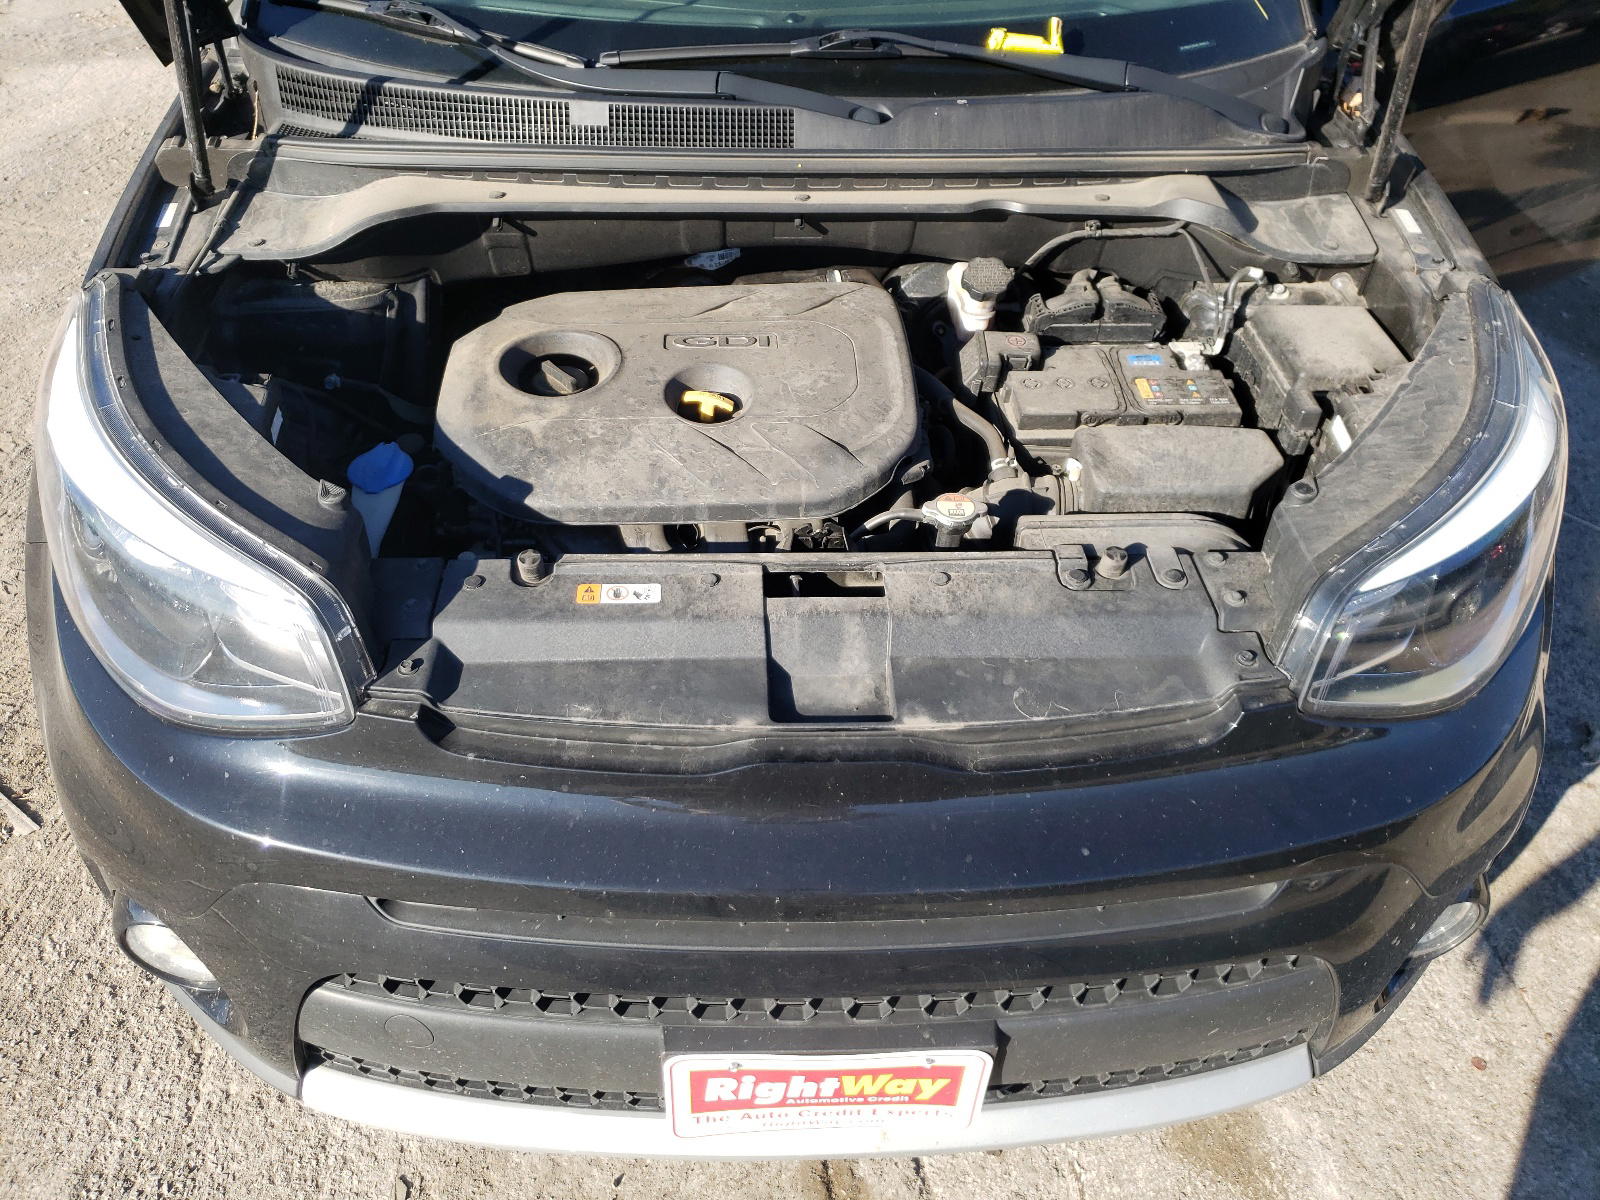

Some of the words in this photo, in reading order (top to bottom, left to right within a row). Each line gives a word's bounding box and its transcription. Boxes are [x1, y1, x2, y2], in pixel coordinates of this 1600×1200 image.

[673, 335, 770, 347] GDI
[704, 1073, 952, 1105] RightWay
[785, 1096, 865, 1105] Automotive
[867, 1095, 910, 1103] Credit
[740, 1111, 789, 1121] Auto
